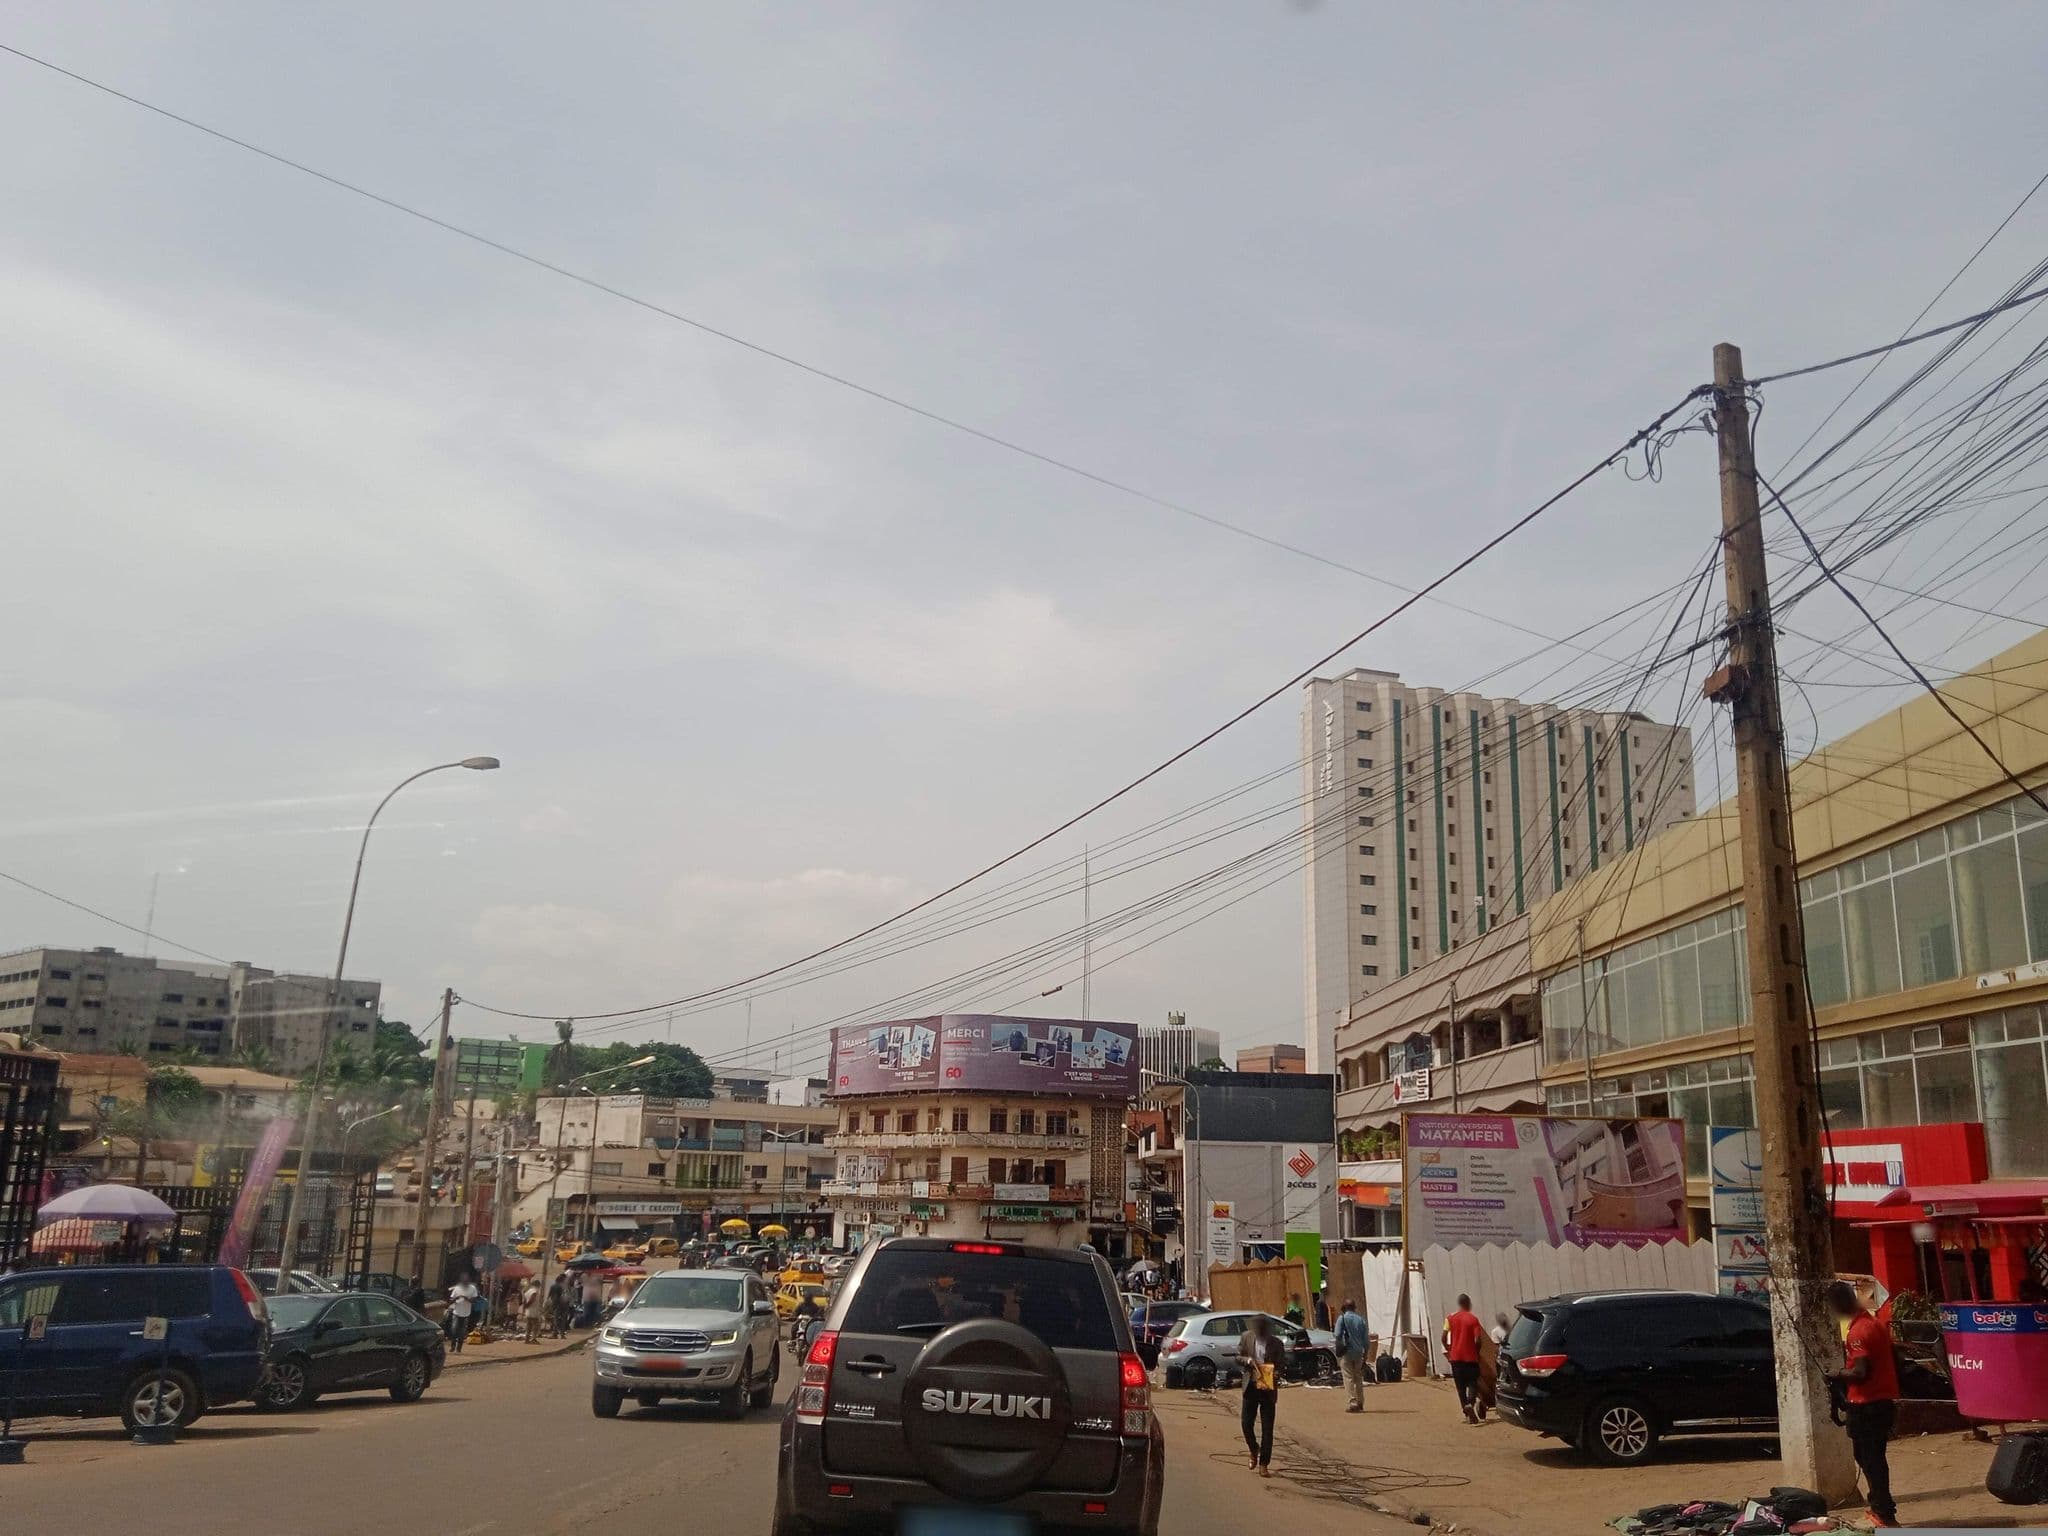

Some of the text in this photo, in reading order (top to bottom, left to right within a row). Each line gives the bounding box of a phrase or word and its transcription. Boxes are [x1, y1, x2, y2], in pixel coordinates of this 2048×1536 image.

[947, 1028, 985, 1039] MERCI
[945, 1067, 963, 1080] 60
[1419, 1121, 1503, 1131] INSTITUT UNIVERSITAIRE
[1419, 1129, 1504, 1142] MATAMFEN
[1422, 1168, 1455, 1177] LICENCE
[1287, 1181, 1317, 1189] access
[1422, 1183, 1454, 1191] MASTER
[922, 1388, 1051, 1420] SUZUKI
